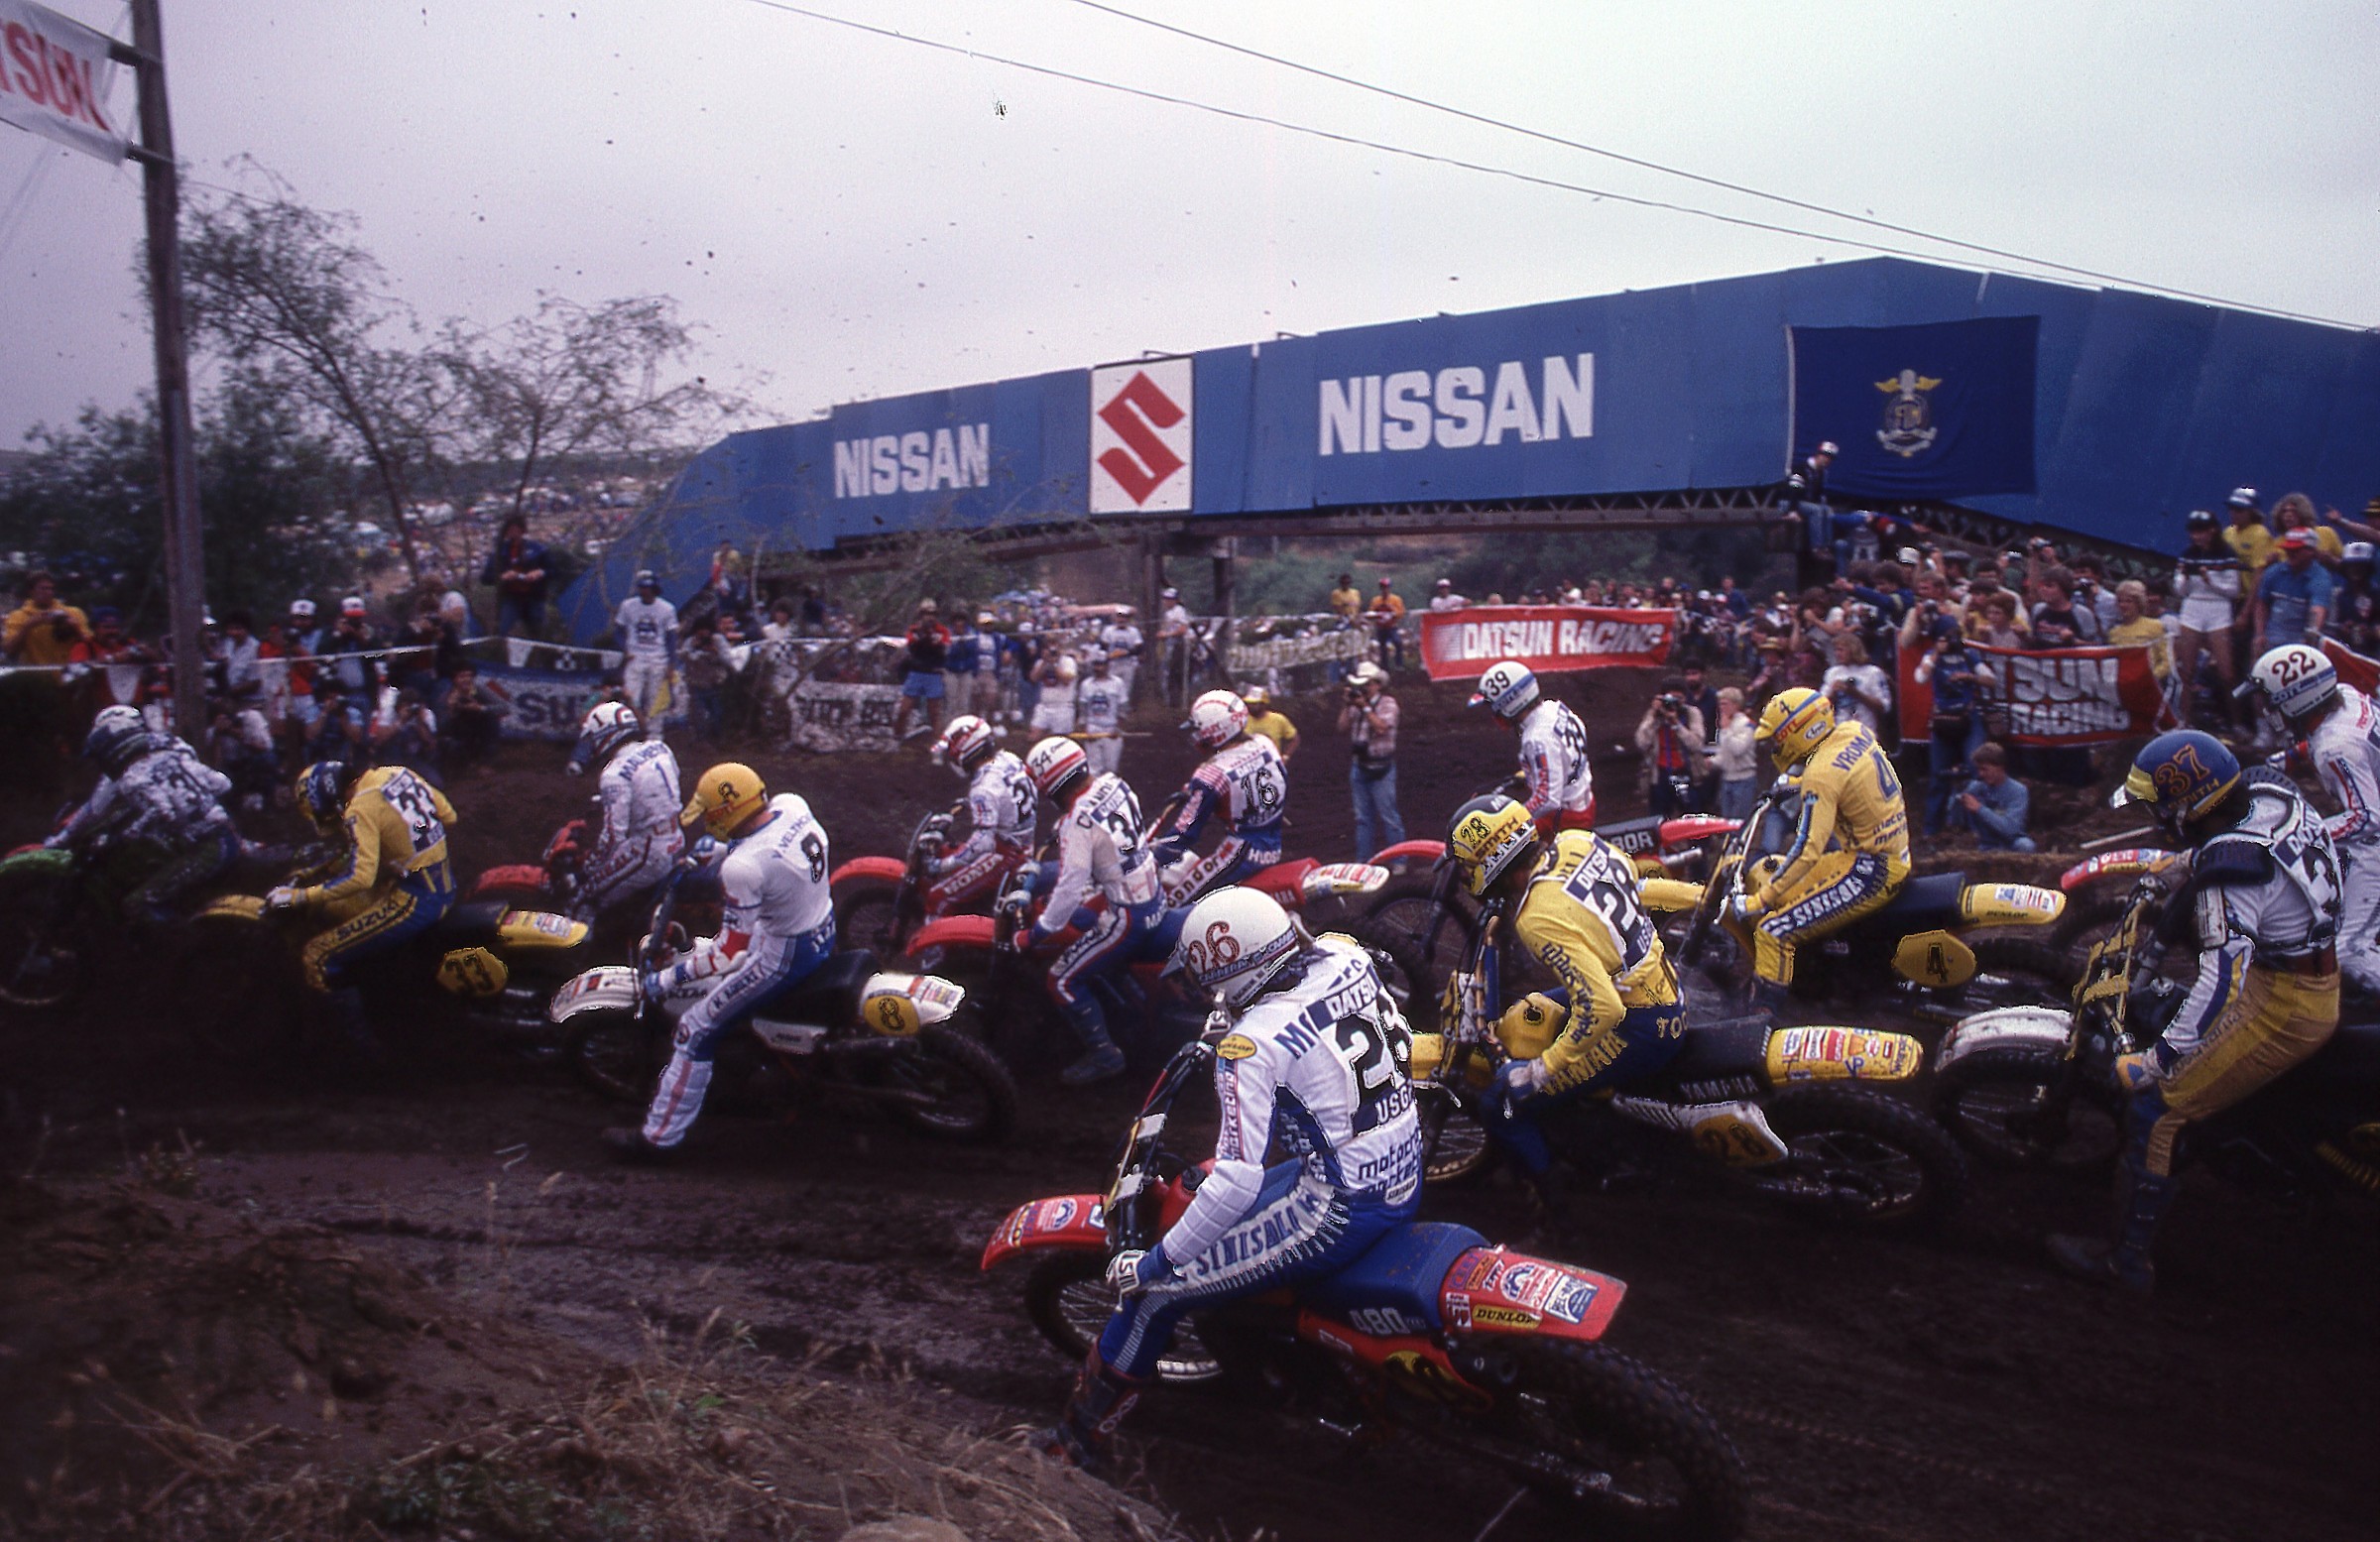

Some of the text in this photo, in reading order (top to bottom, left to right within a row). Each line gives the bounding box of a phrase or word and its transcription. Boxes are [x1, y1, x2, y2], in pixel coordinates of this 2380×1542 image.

[1319, 353, 1594, 455] NISSAN
[834, 423, 989, 498] NISSAN
[1464, 621, 1664, 659] DATSUN RACING
[1486, 651, 1510, 696] 39
[2272, 652, 2317, 686] 22
[2009, 702, 2130, 735] RACING
[1031, 751, 1052, 776] 34
[1871, 749, 1898, 801] 4
[2155, 745, 2210, 796] 37
[396, 779, 437, 838] 33
[1241, 768, 1274, 808] 16
[1461, 816, 1490, 849] 28
[800, 831, 824, 884] 8
[942, 854, 1005, 895] HONDA
[1592, 857, 1645, 954] 28
[1187, 921, 1241, 974] 26
[1927, 942, 1946, 983] 4
[444, 953, 494, 992] 33
[879, 997, 904, 1031] 8
[1335, 992, 1412, 1113] 26
[1680, 1074, 1760, 1099] YAMAHA
[1702, 1123, 1769, 1161] 28
[1349, 1306, 1411, 1335] 480
